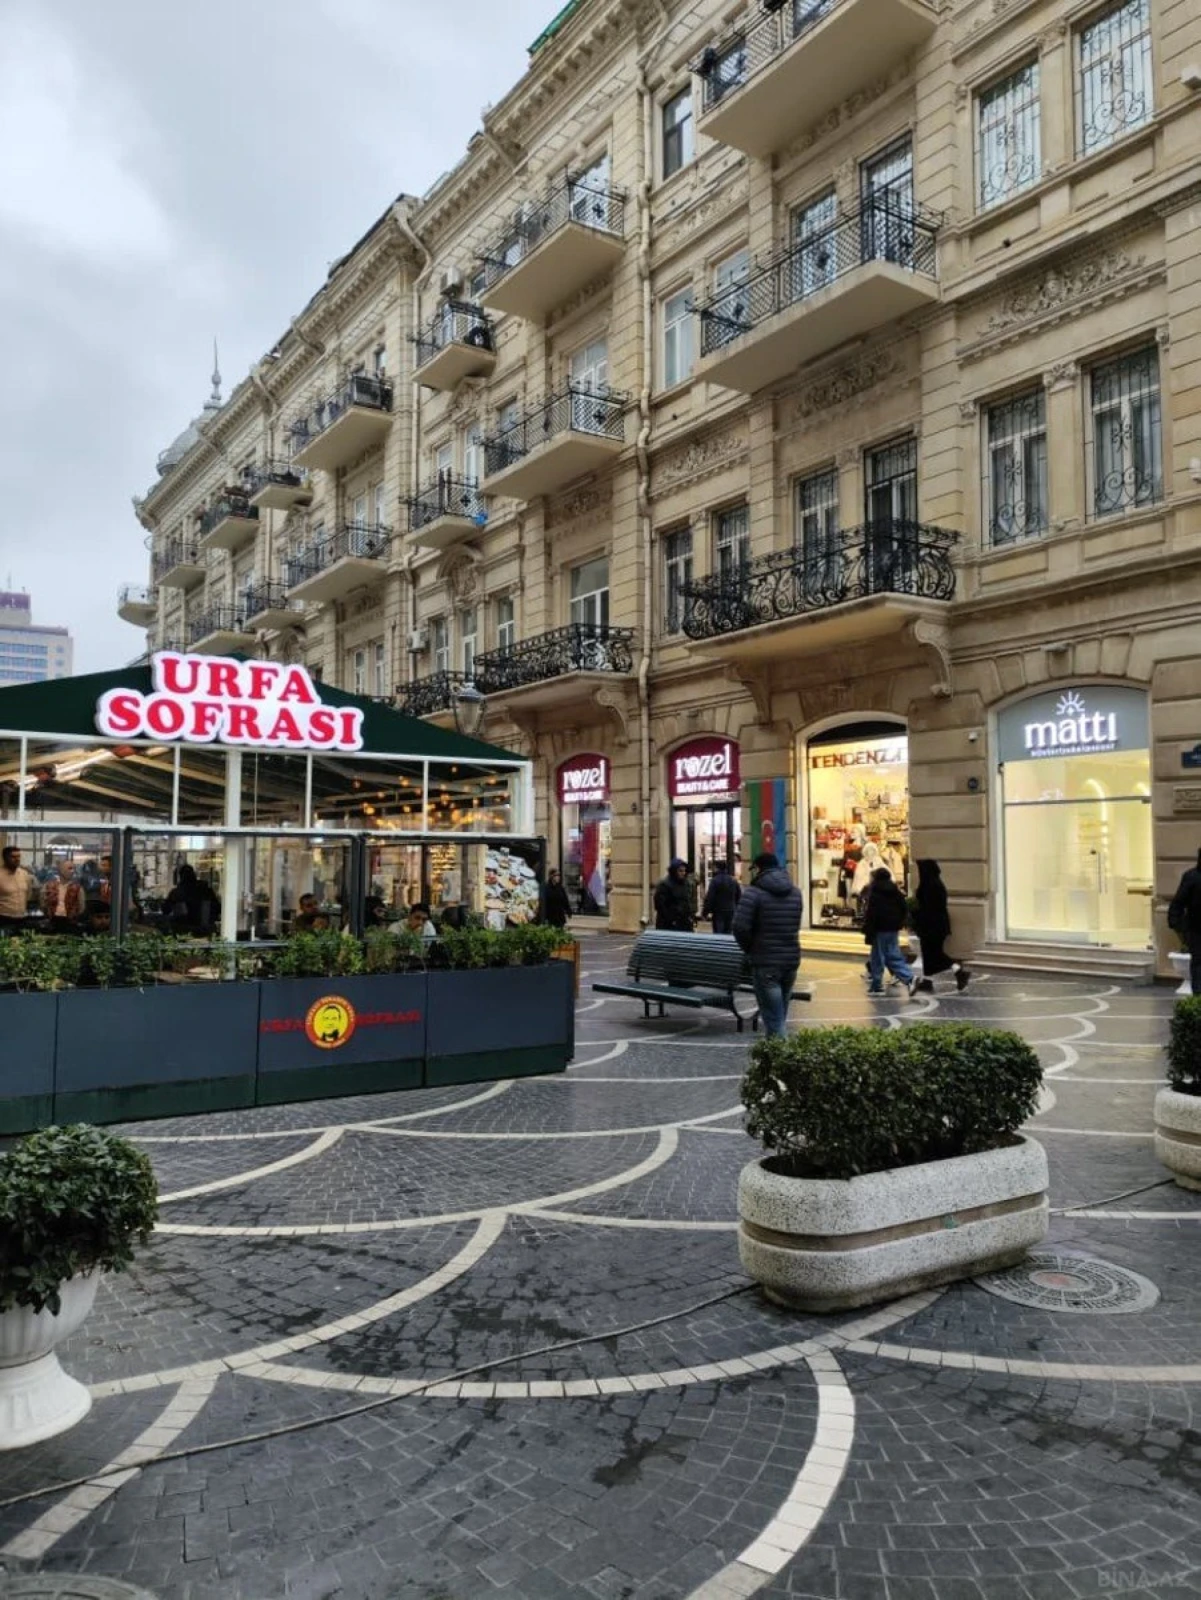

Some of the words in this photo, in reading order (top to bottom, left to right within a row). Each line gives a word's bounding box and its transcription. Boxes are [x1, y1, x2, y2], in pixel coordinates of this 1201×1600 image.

[161, 657, 314, 704] URFA
[108, 695, 356, 744] SOFRASI
[563, 759, 606, 790] rozel
[675, 743, 731, 780] rozel
